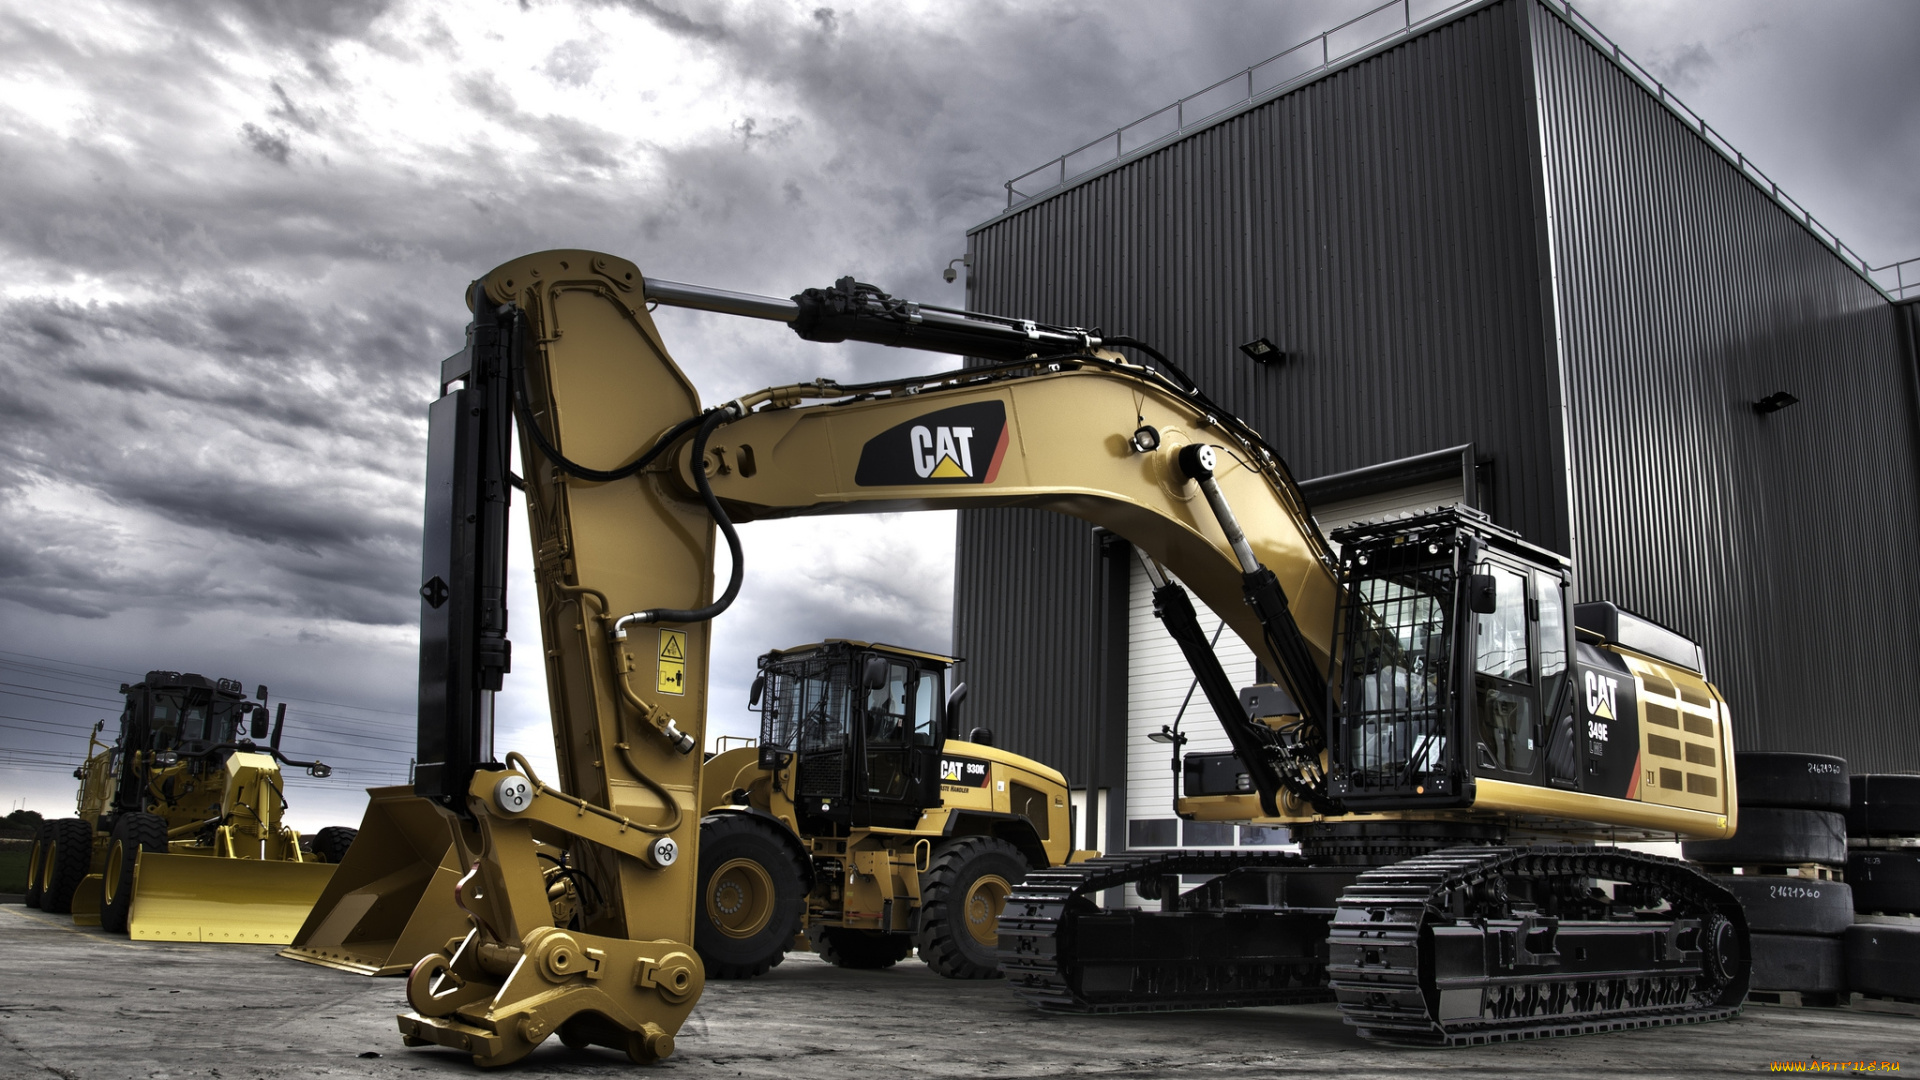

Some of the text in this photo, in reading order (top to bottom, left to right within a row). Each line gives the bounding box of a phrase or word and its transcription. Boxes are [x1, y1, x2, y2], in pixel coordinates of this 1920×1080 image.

[910, 425, 974, 478] CAT
[1585, 670, 1618, 721] CAT
[1588, 720, 1609, 741] 349E
[940, 760, 985, 781] CAT 930K
